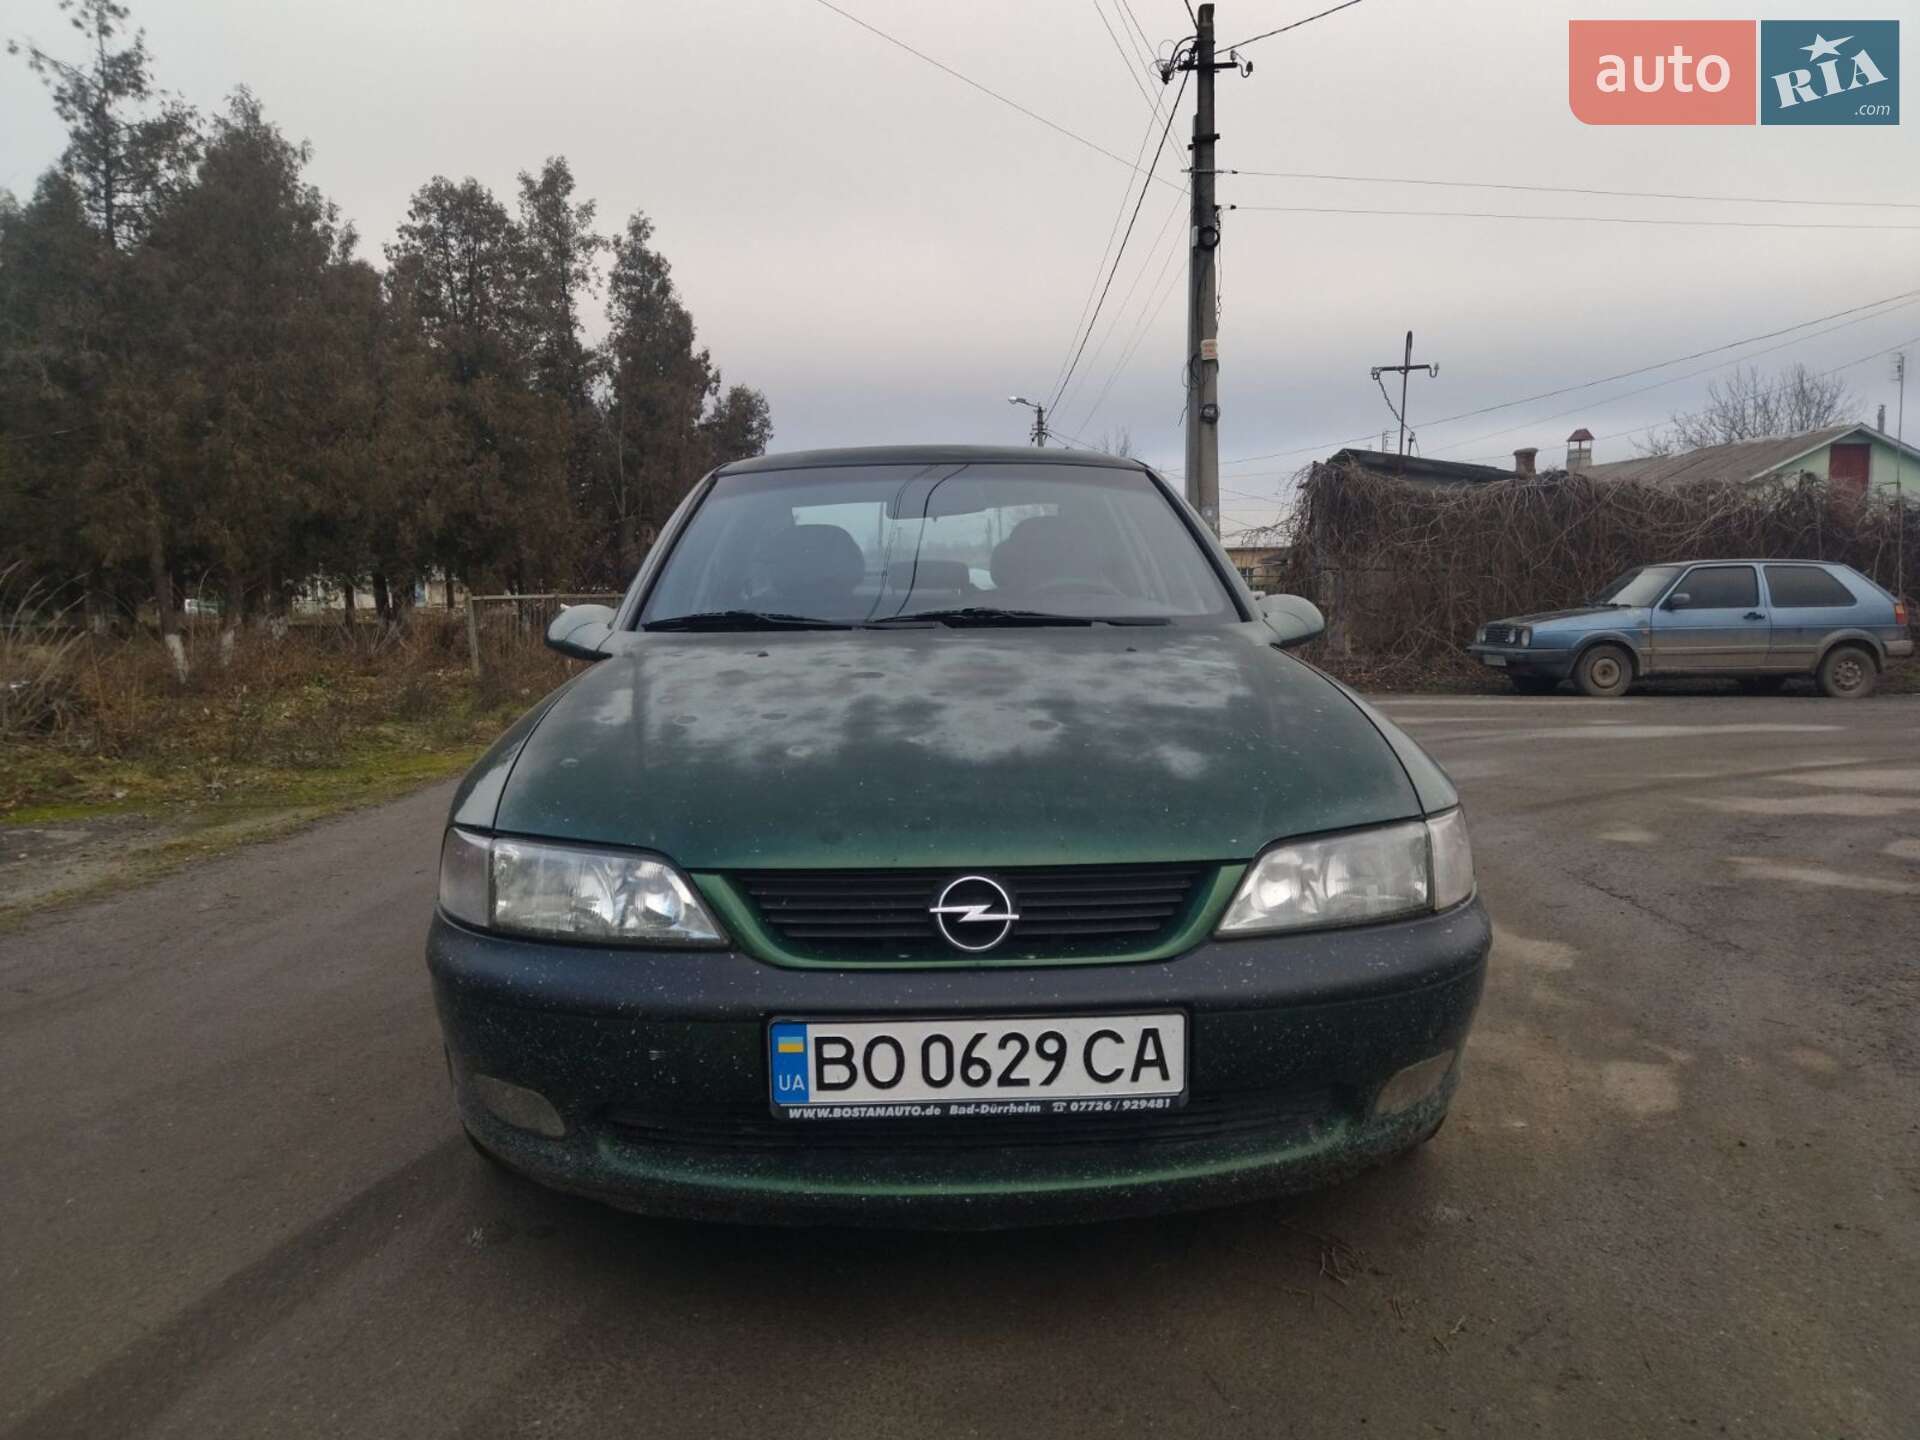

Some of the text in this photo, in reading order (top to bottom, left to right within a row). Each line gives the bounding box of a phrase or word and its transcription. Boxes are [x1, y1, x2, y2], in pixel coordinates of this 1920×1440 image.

[814, 1027, 1171, 1091] BO 0629 CA
[778, 1074, 805, 1091] UA
